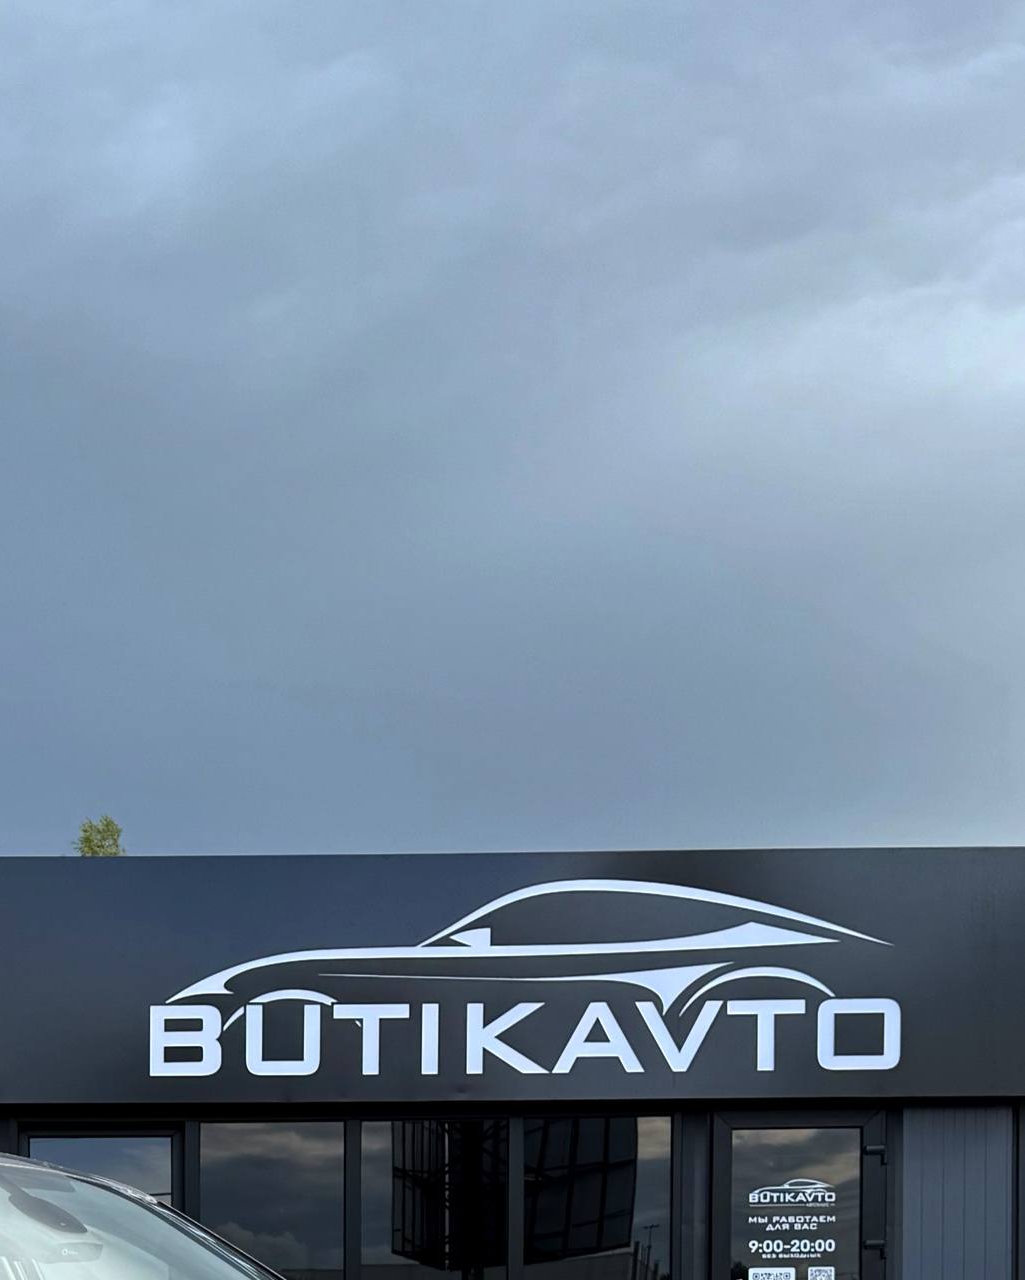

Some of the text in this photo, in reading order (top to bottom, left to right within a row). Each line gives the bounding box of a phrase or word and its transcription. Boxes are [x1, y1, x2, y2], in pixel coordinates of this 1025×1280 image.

[150, 998, 903, 1077] BUTIKAVTO
[748, 1192, 836, 1203] BUTIKAVTO
[748, 1215, 836, 1224] МЫ РАБОТАЕМ
[765, 1222, 818, 1231] ДЛЯ ВАС
[748, 1239, 836, 1253] 9:00-20:00
